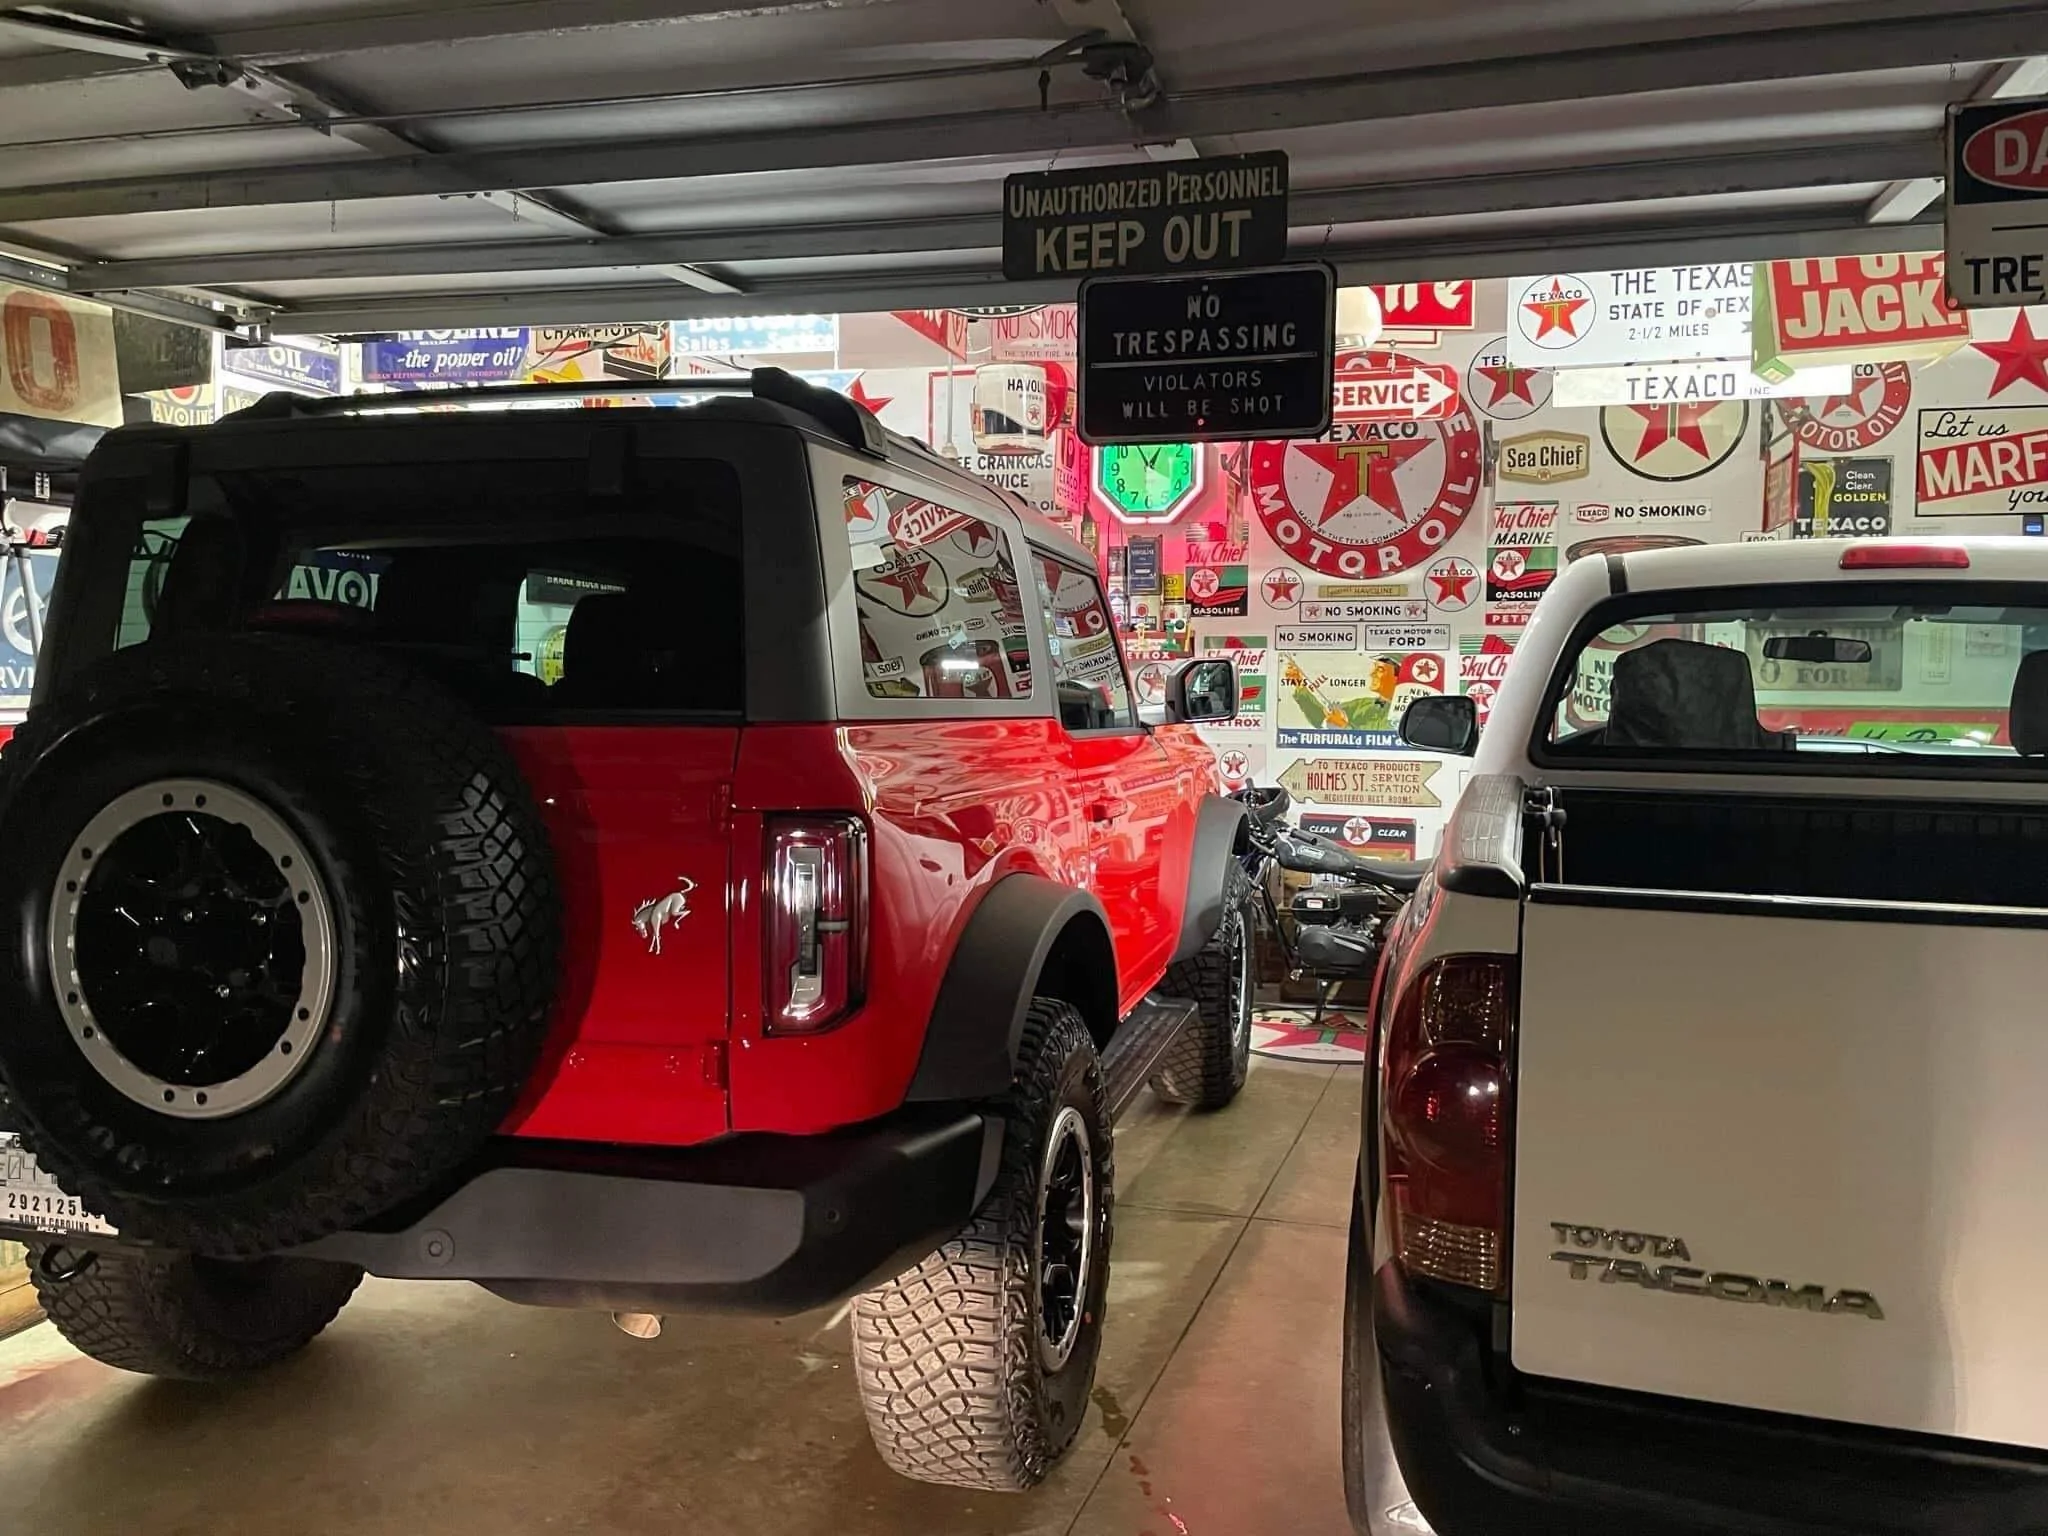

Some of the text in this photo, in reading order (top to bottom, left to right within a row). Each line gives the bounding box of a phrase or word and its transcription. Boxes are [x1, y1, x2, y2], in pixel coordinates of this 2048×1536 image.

[1035, 210, 1254, 273] KEEP OUT
[1611, 270, 1657, 296] THE
[1531, 289, 1583, 302] TEXACO
[1186, 294, 1221, 319] NO
[1609, 301, 1665, 321] STATE
[1677, 299, 1703, 317] OF
[997, 315, 1020, 340] NO
[1669, 323, 1710, 338] MILES
[1113, 323, 1297, 357] TRESPASSING
[434, 351, 490, 373] power
[1144, 370, 1262, 392] VIOLATORS
[1626, 373, 1736, 401] TEXACO
[1122, 394, 1284, 420] WILL BE SHOT
[1867, 405, 1903, 436] OIL
[1924, 412, 2010, 438] Let us
[1507, 445, 1586, 468] Sea Chief
[1111, 463, 1120, 477] 9
[1181, 462, 1190, 475] 3
[1116, 479, 1126, 494] 8
[1175, 480, 1182, 492] 4
[1833, 492, 1887, 502] GOLDEN
[1517, 505, 1558, 528] Chief
[1578, 508, 1608, 517] TEXACO
[1615, 505, 1707, 518] NO SMOKING
[1255, 484, 1402, 575] MOTOR
[1797, 517, 1887, 531] TEXACO
[1494, 531, 1555, 546] MARINE
[1211, 542, 1249, 562] Chief
[1432, 569, 1474, 577] TEXACO
[1193, 607, 1240, 615] GASOLINE
[1326, 606, 1401, 617] NO SMOKING
[1278, 632, 1354, 642] NO SMOKING
[1389, 637, 1427, 647] FORD
[1459, 656, 1488, 680] Sky
[1281, 674, 1366, 692] STAYS FULL LONGER
[1796, 668, 1848, 685] FOR
[1409, 688, 1431, 696] NEW
[1279, 734, 1298, 744] The
[1318, 762, 1421, 772] TO TEXACO PRODUCTS
[1307, 773, 1369, 792] HOLMES ST.
[1372, 774, 1420, 783] SERVICE
[1371, 784, 1420, 794] STATION
[1378, 829, 1408, 838] CLEAR
[19, 1214, 46, 1226] NORTH
[1550, 1222, 1691, 1262] TOYOTA
[1549, 1251, 1886, 1321] TACOMA
